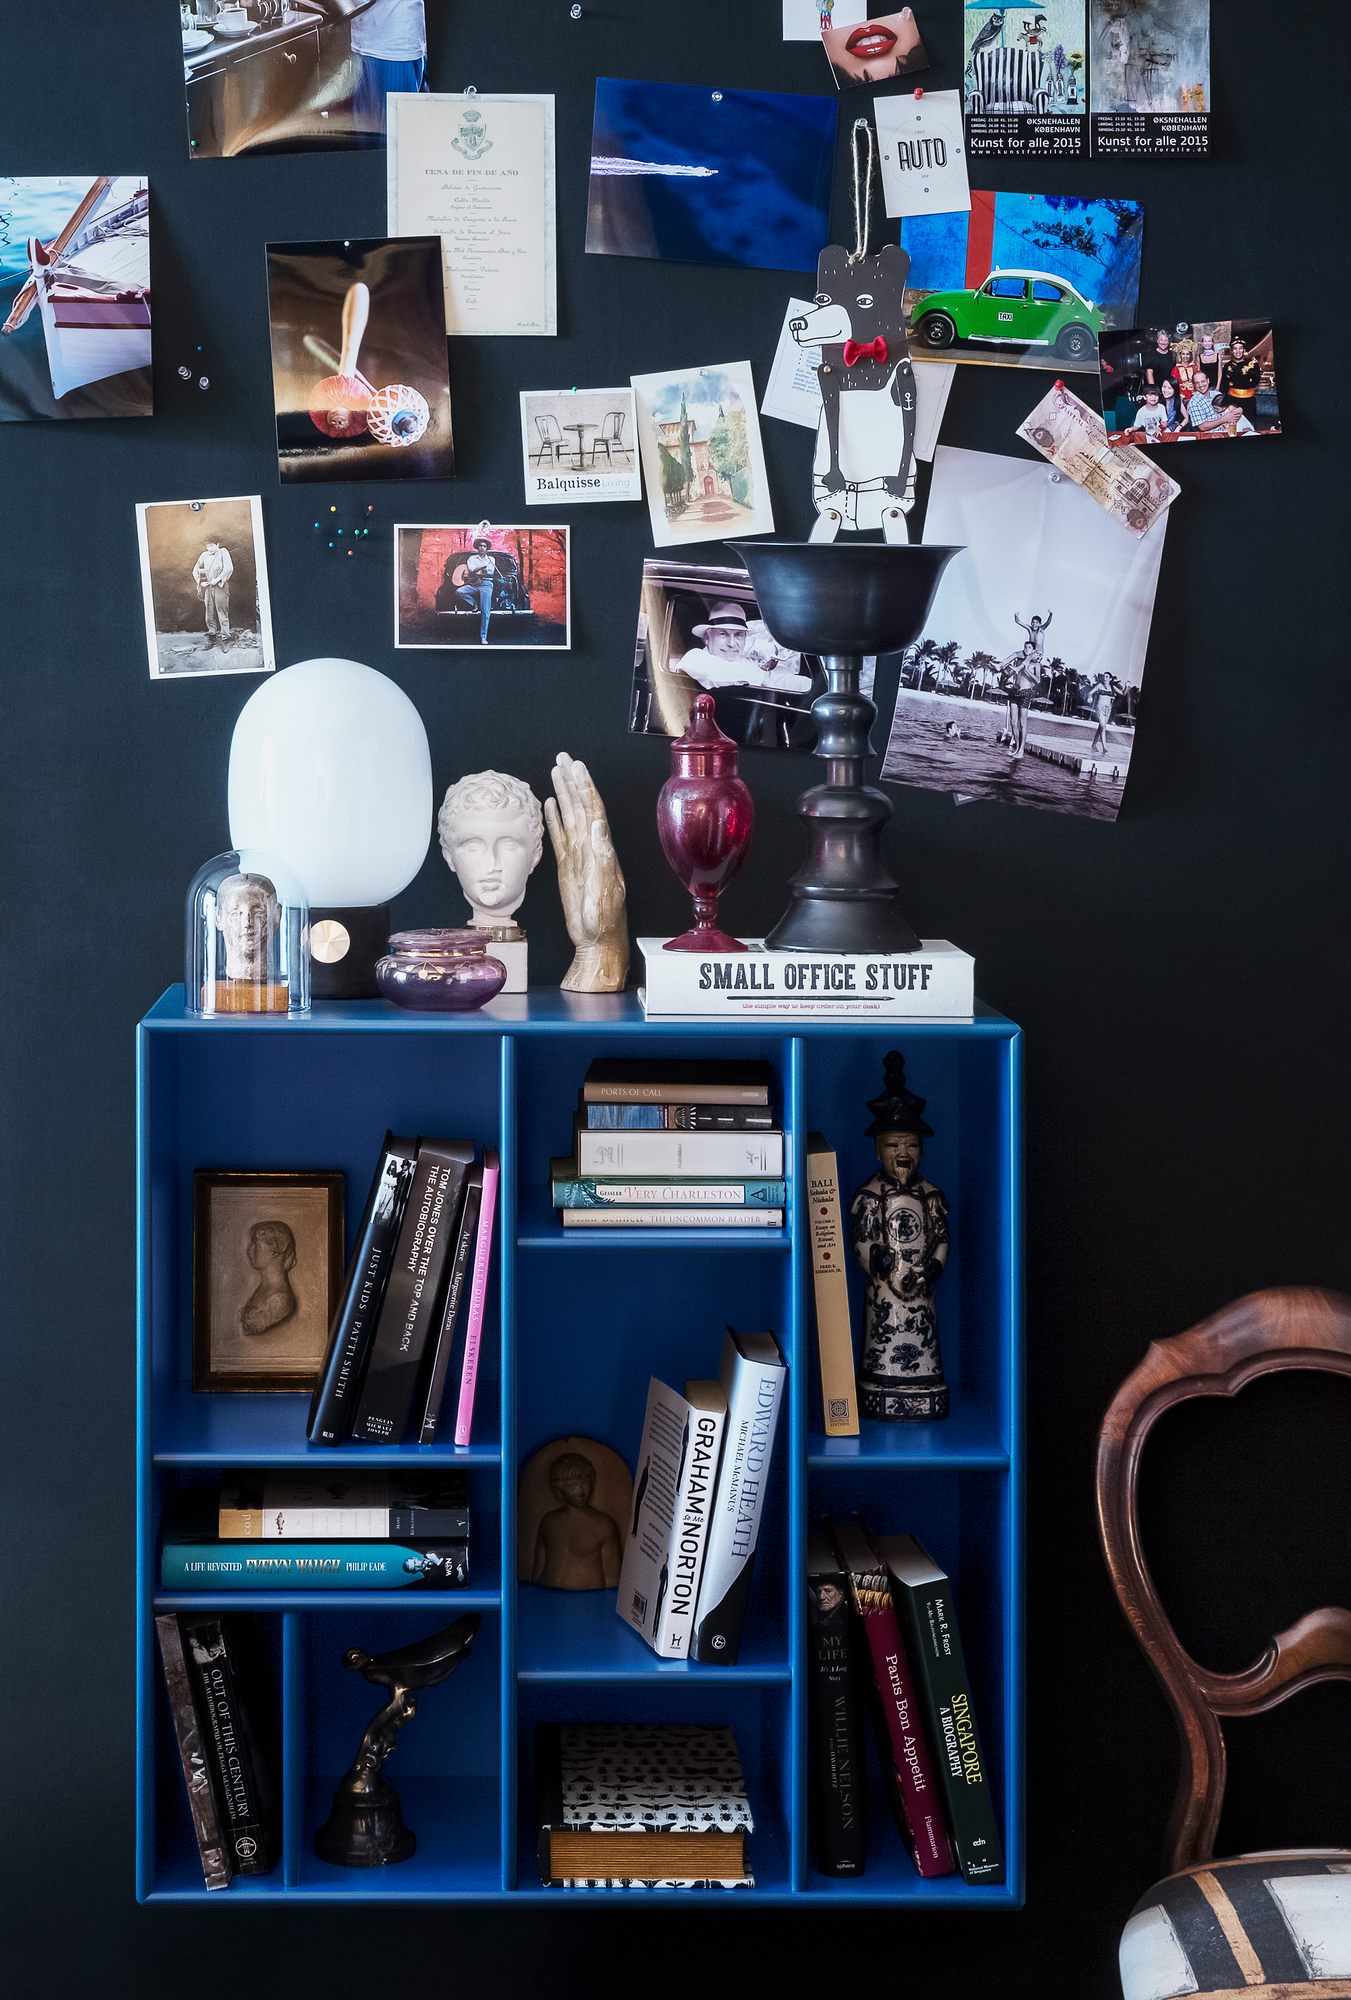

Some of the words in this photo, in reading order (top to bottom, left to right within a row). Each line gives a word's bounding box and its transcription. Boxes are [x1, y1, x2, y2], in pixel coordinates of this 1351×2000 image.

[898, 138, 947, 171] AUTO
[970, 138, 1004, 148] Kunst
[1008, 138, 1025, 148] for
[1028, 138, 1049, 148] alle
[1053, 138, 1081, 148] 2015
[1098, 136, 1130, 146] Kunst
[1134, 136, 1152, 146] for
[1155, 136, 1176, 146] alle
[1180, 136, 1208, 146] 2015
[536, 476, 600, 491] Balquisse
[602, 479, 630, 488] Living
[699, 962, 775, 990] SMALL
[784, 963, 856, 990] OFFICE
[865, 964, 933, 991] STUFF
[754, 1003, 776, 1011] simple
[800, 1003, 815, 1011] keep
[601, 1088, 627, 1096] PORTS
[629, 1088, 640, 1096] OF
[642, 1088, 662, 1097] CALL
[427, 1165, 439, 1185] THE
[438, 1168, 451, 1190] TOM
[811, 1179, 833, 1188] BALI
[624, 1187, 657, 1200] VERY
[662, 1187, 742, 1200] CHARLESTON
[430, 1194, 444, 1225] JONES
[407, 1186, 433, 1272] AUTOBIOGRAPHY
[423, 1226, 438, 1254] OVER
[463, 1231, 470, 1242] At
[367, 1247, 382, 1278] JUST
[459, 1242, 469, 1261] skrive
[476, 1220, 489, 1284] MARGUERITE
[418, 1256, 430, 1276] THE
[359, 1281, 373, 1310] KIDS
[414, 1278, 426, 1298] TOP
[449, 1272, 463, 1308] Marguerite
[407, 1299, 419, 1321] AND
[472, 1288, 482, 1321] DURAS
[445, 1309, 456, 1331] Duras
[347, 1321, 362, 1356] PATTI
[400, 1324, 414, 1352] BACK
[466, 1335, 477, 1385] ELSKEREN
[335, 1360, 352, 1398] SMITH
[366, 1422, 392, 1431] MICHAEL
[367, 1428, 389, 1436] JOSEPH
[368, 1416, 393, 1425] PENGUIN
[747, 1378, 777, 1473] EDWARD
[734, 1420, 749, 1463] MICHAEL
[686, 1418, 716, 1514] GRAHAM
[242, 1513, 251, 1535] cod
[731, 1478, 760, 1558] HEATH
[184, 1563, 190, 1571] A
[191, 1563, 205, 1571] LIFE
[207, 1562, 242, 1571] REVISITED
[246, 1559, 292, 1574] EVELYN
[295, 1559, 341, 1574] WAUGH
[346, 1562, 367, 1571] PHILIP
[369, 1562, 386, 1571] EADE
[671, 1522, 701, 1615] NORTON
[822, 1636, 842, 1647] MY
[940, 1623, 948, 1633] R.
[818, 1648, 847, 1660] LIFE
[211, 1669, 226, 1697] OUT
[828, 1675, 841, 1683] Story
[205, 1686, 221, 1741] AUTOBIOGRAPHY
[217, 1700, 231, 1722] OF
[835, 1695, 849, 1754] WILLIE
[885, 1654, 902, 1696] Paris
[896, 1698, 910, 1731] Bon
[903, 1735, 926, 1792] Appetit
[940, 1707, 950, 1715] A
[221, 1723, 237, 1753] THIS
[942, 1716, 963, 1777] BIOGRAPHY
[951, 1694, 983, 1785] SINGAPORE
[218, 1750, 227, 1772] PEGGY
[222, 1773, 236, 1820] GUGGENHEIM
[228, 1756, 250, 1818] CENTURY
[839, 1759, 854, 1829] NELSON
[925, 1815, 938, 1859] Flammarion
